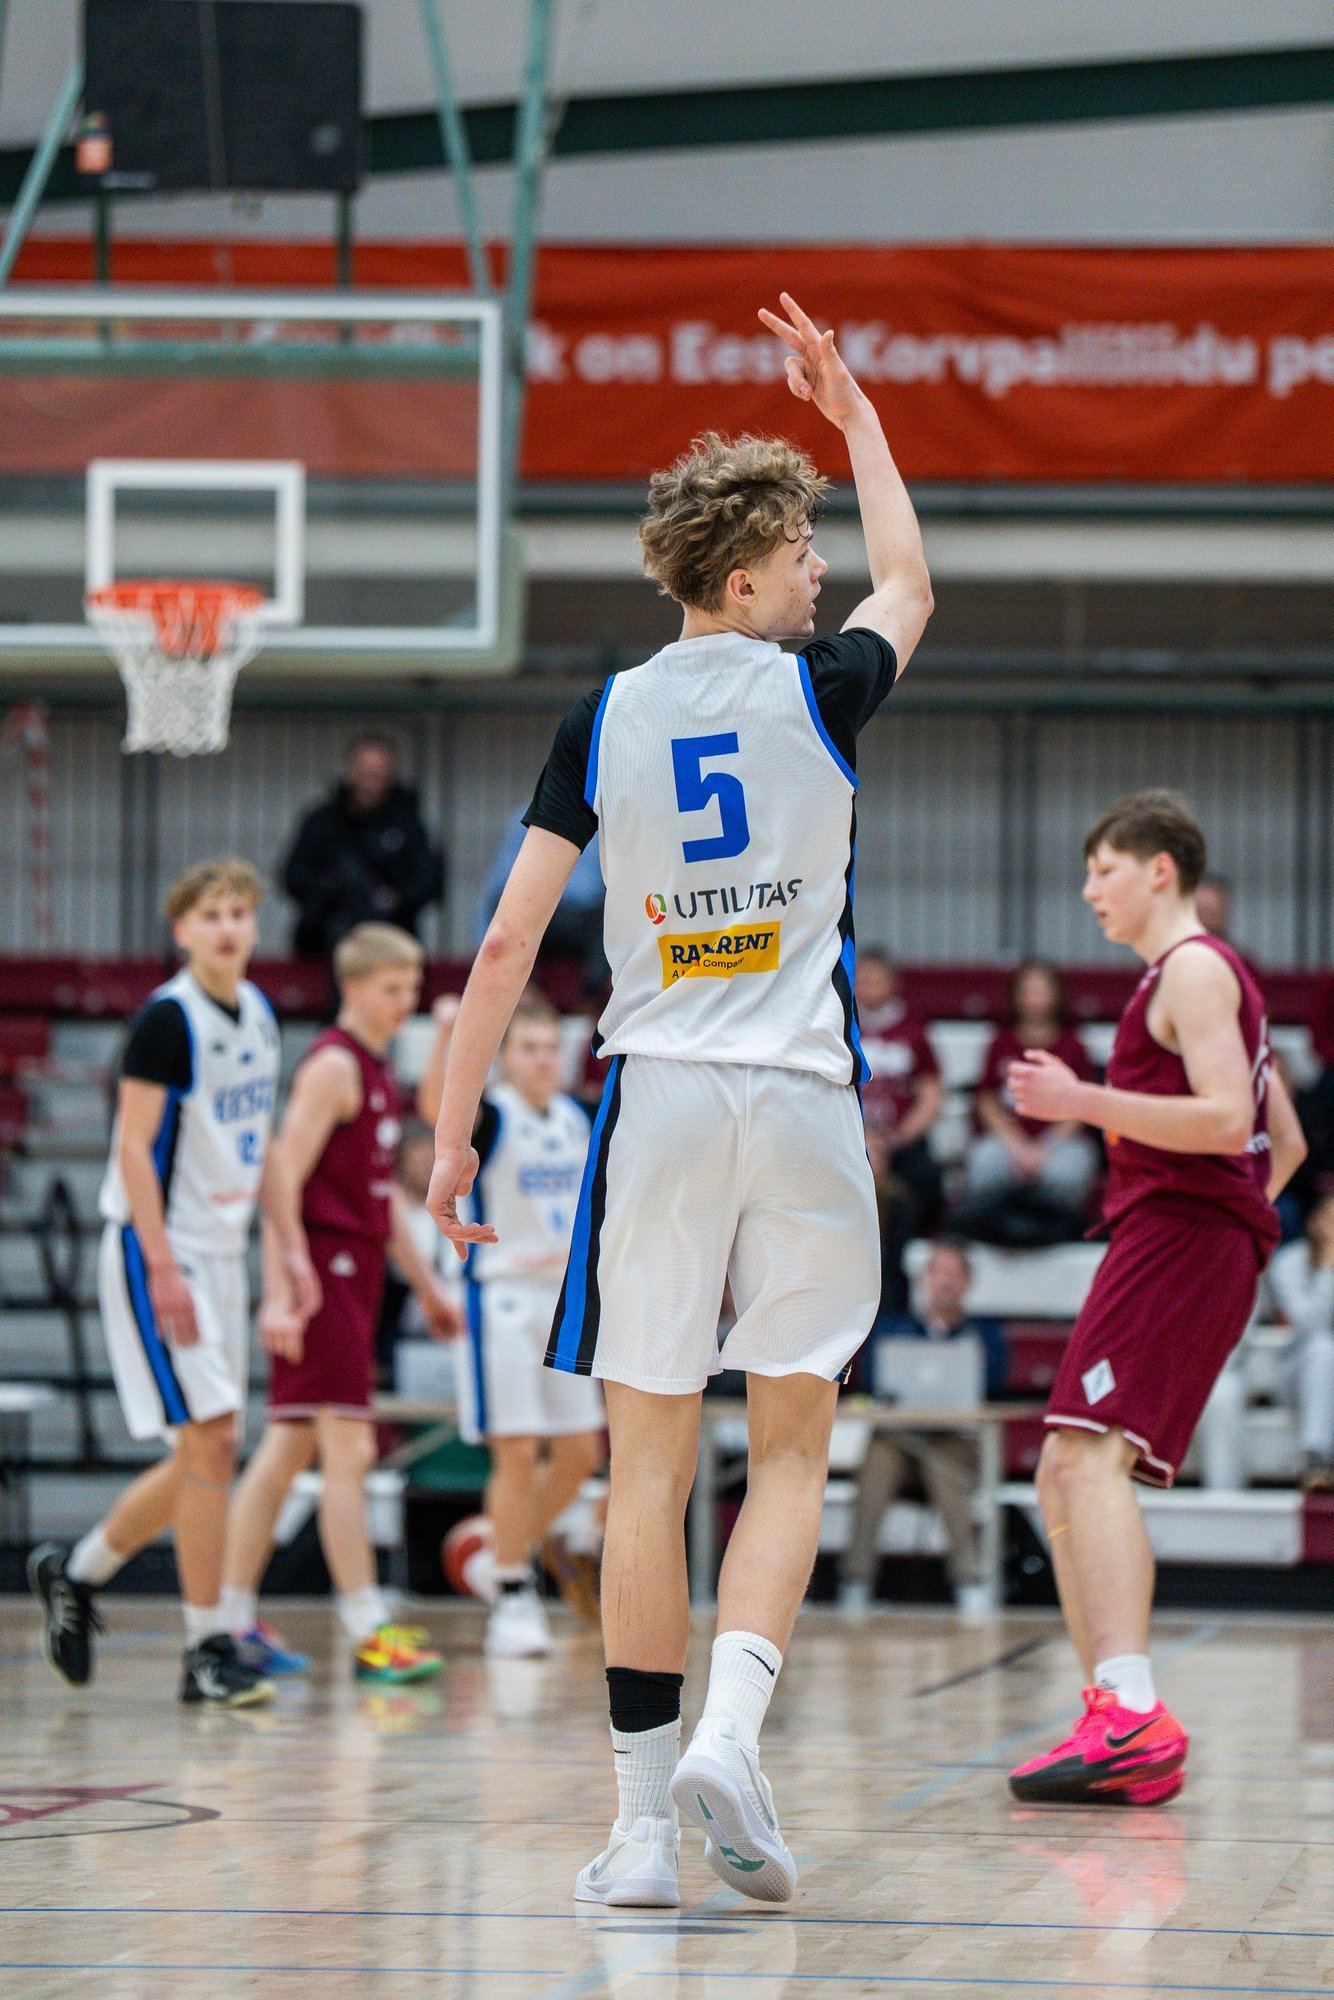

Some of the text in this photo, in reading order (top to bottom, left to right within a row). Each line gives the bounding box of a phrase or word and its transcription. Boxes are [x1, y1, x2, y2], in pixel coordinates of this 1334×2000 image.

[574, 333, 663, 385] on
[671, 320, 832, 386] Ees
[671, 731, 750, 863] 5
[673, 879, 803, 919] UTILITAS
